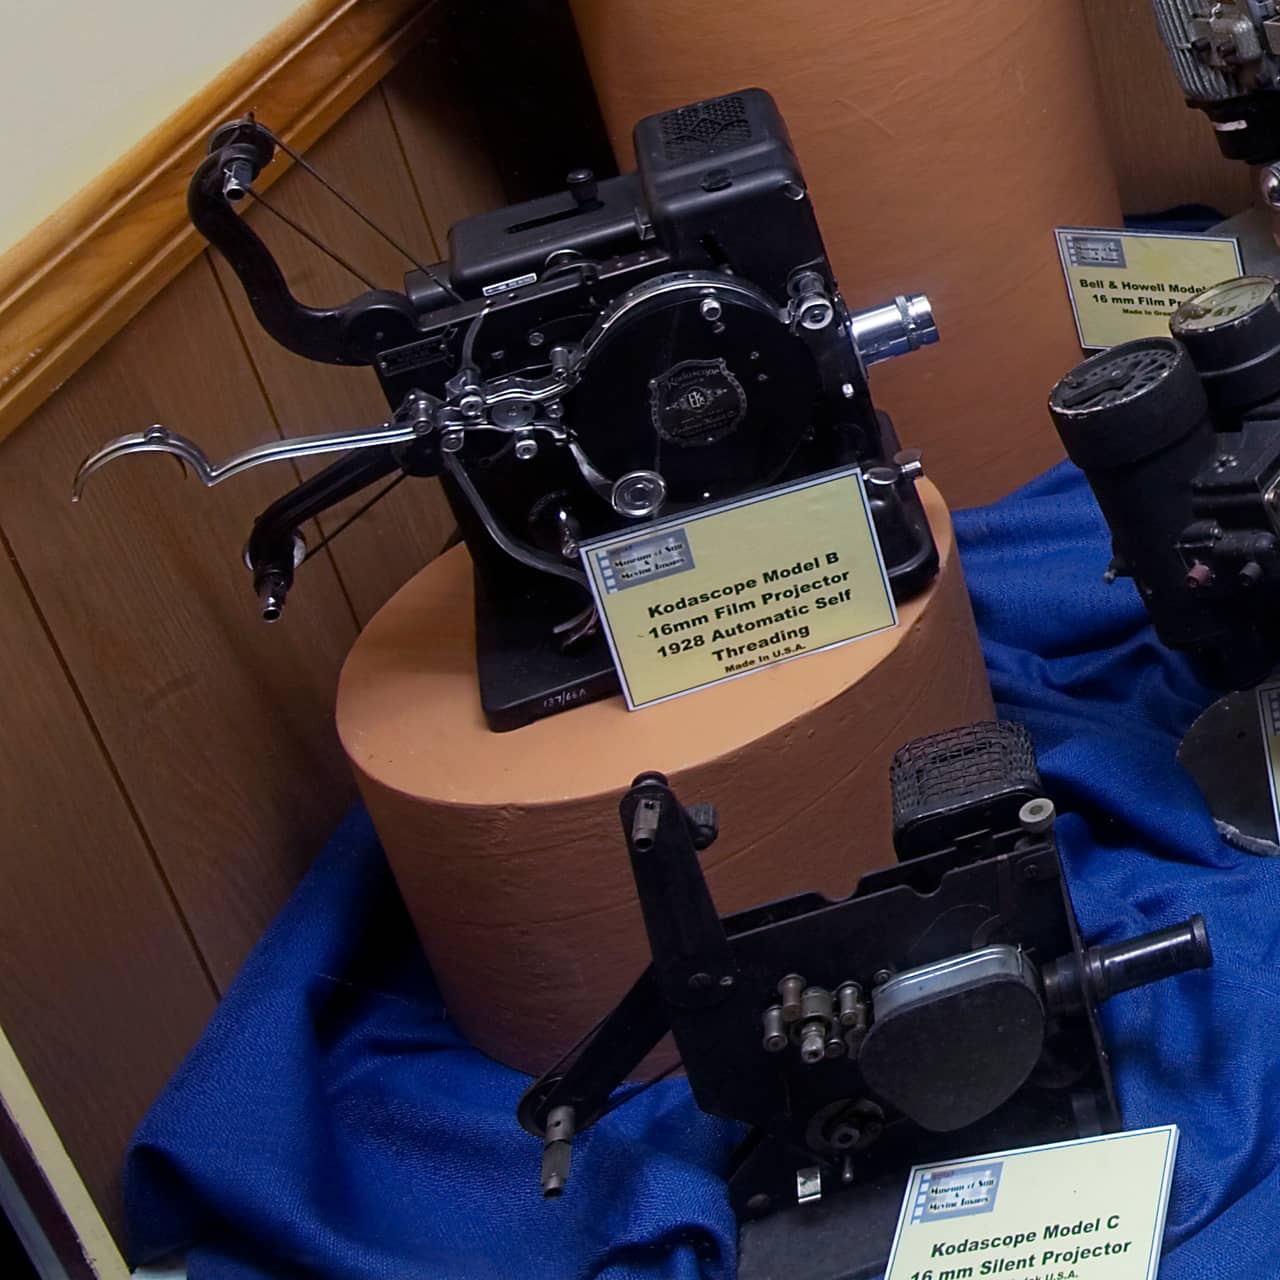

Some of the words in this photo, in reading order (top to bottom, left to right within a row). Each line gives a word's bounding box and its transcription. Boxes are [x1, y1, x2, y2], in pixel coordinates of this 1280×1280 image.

[1080, 279, 1104, 289] Bell
[1109, 281, 1118, 289] &
[1122, 282, 1165, 292] Howell
[1092, 294, 1108, 303] 16
[1112, 297, 1134, 305] mm
[1139, 297, 1165, 306] Film
[648, 578, 756, 618] Kodascope
[763, 557, 820, 584] Model
[827, 552, 839, 563] B
[649, 613, 708, 639] 16mm
[714, 598, 756, 622] Film
[762, 571, 849, 606] Projector
[658, 635, 704, 658] 1928
[712, 604, 809, 642] Automatic
[816, 589, 852, 610] Self
[713, 624, 810, 662] Threading
[725, 658, 755, 673] Made
[759, 654, 769, 662] In
[773, 643, 806, 659] U.S.A.
[931, 1230, 1036, 1258] Kodascope
[1043, 1218, 1100, 1240] Model
[1107, 1215, 1120, 1229] C
[911, 1270, 932, 1280] 16
[939, 1266, 972, 1280] mm
[980, 1254, 1035, 1275] Silent
[1042, 1240, 1131, 1265] Projector
